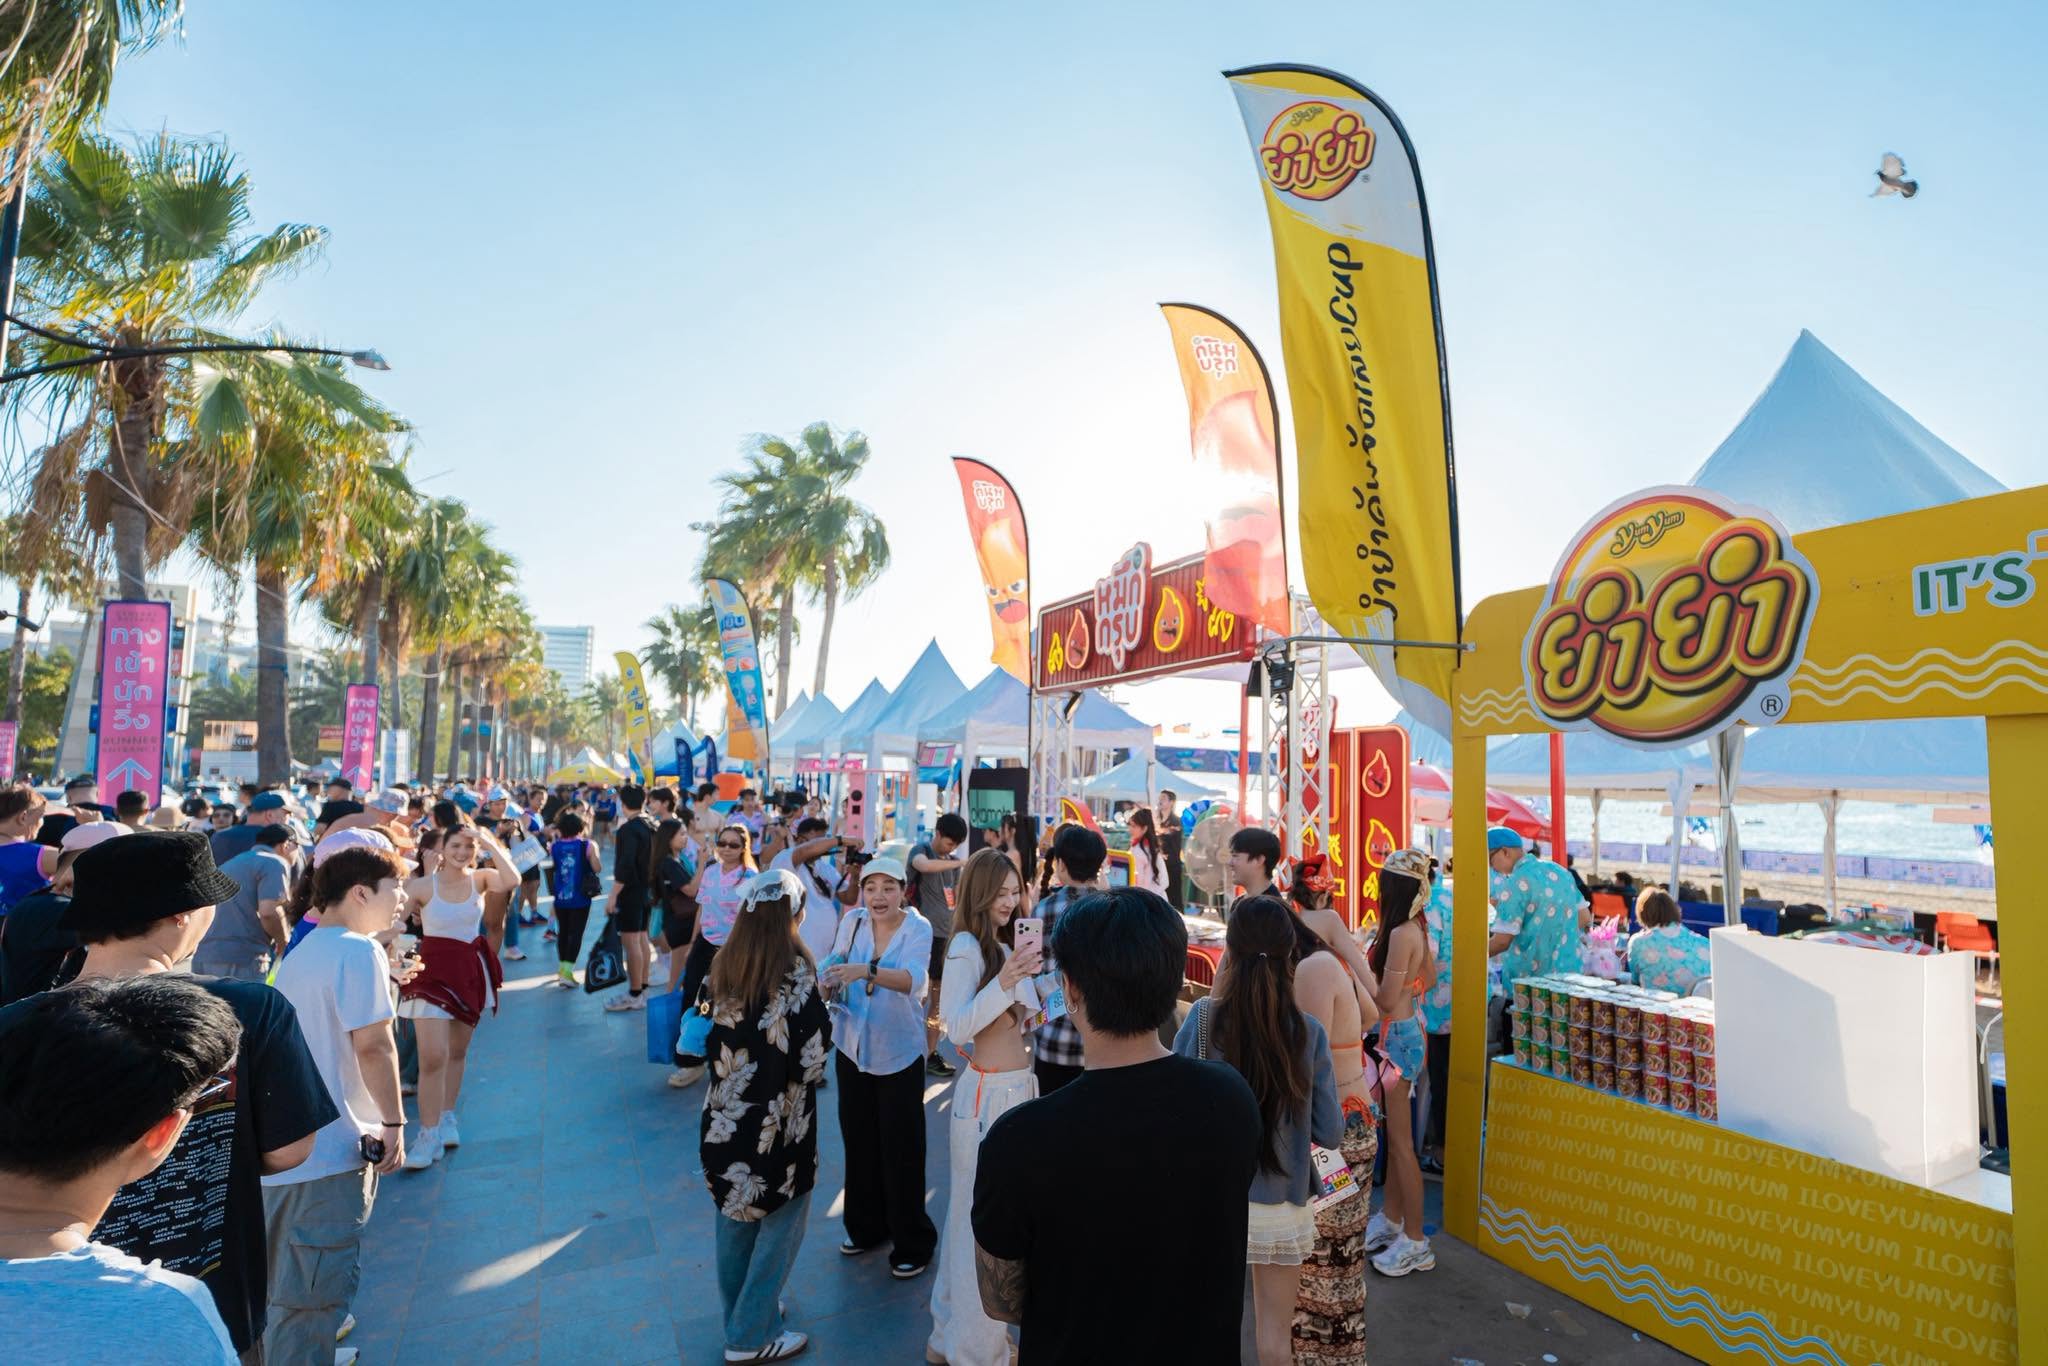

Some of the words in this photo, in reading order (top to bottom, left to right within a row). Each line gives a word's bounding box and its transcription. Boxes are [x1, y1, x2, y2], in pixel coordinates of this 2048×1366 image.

[1918, 556, 2029, 611] IT'S
[110, 626, 162, 646] ทาง
[1534, 526, 1803, 710] ยำยำ
[114, 650, 156, 674] เข้า
[112, 703, 151, 731] วิ่ง
[113, 679, 153, 702] นัก
[1622, 1149, 1789, 1201] ILOVEYUMYUM
[1551, 1160, 1699, 1212] ILOVEYUMYUM
[1704, 1196, 1901, 1262] ILOVEYUMYUM
[1615, 1205, 1783, 1265] ILOVEYUMYUM
[1703, 1257, 1900, 1333] ILOVEYUMYUM
[1913, 1316, 2018, 1363] ILOVE
